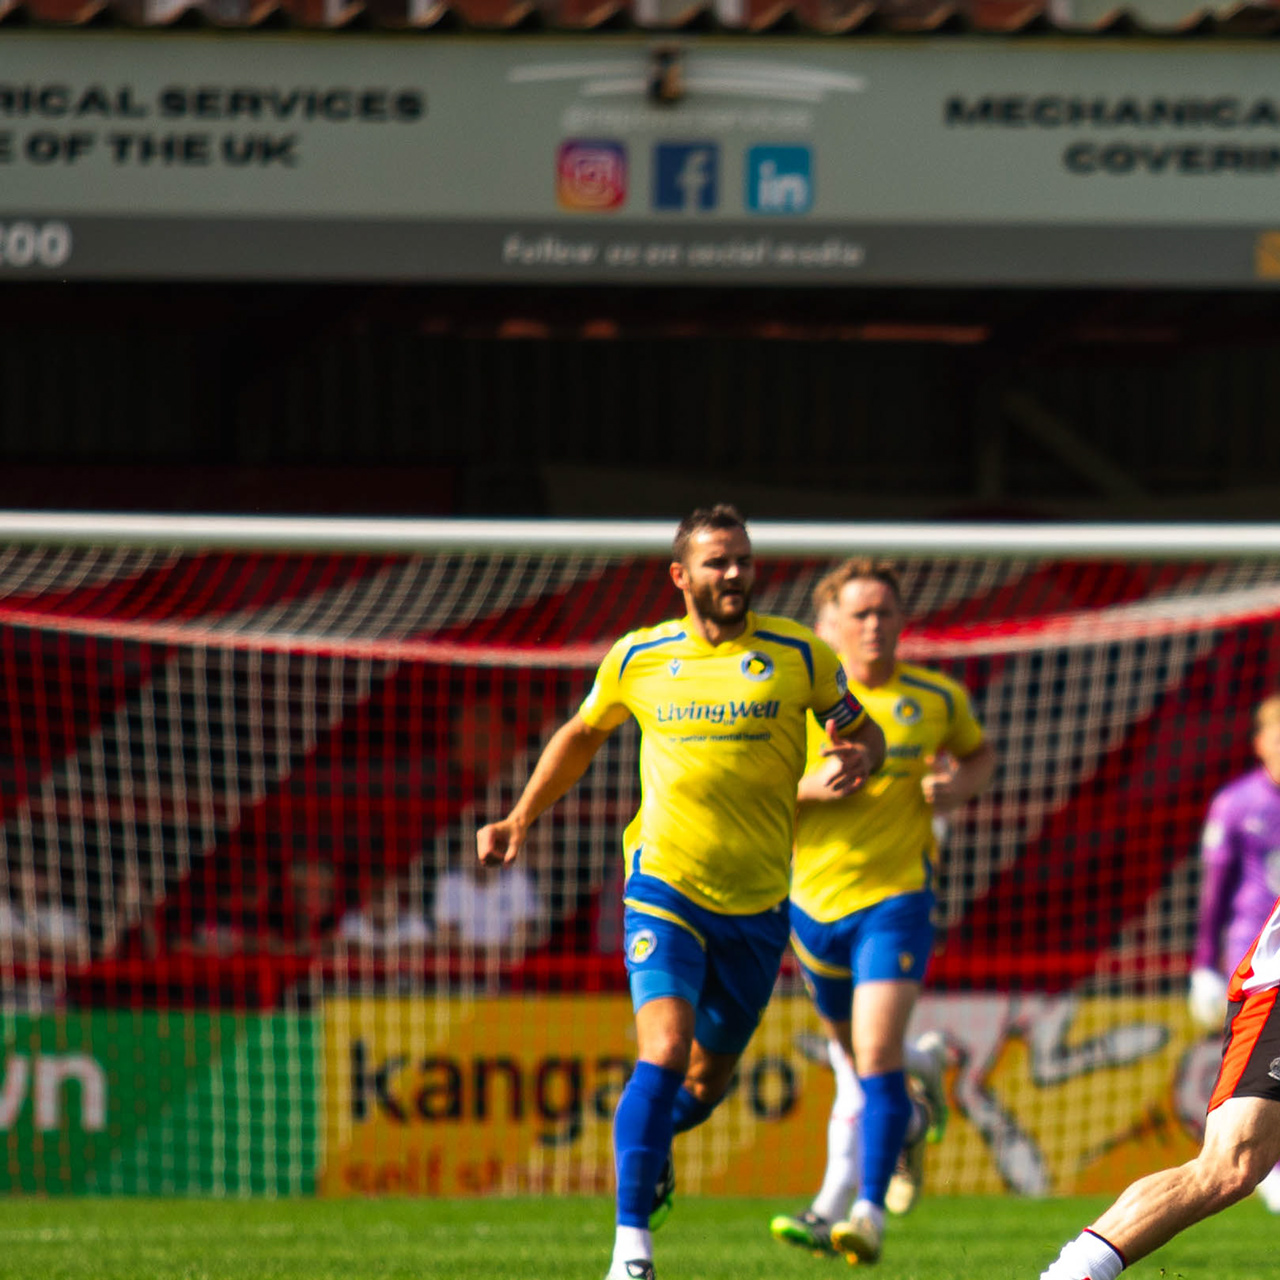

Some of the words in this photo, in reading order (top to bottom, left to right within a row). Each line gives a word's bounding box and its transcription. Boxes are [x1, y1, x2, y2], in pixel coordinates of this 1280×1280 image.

[160, 86, 428, 123] SERVICES
[25, 131, 96, 166] OF
[105, 132, 211, 167] THE
[221, 133, 301, 169] UK
[0, 221, 73, 268] 00
[349, 1040, 798, 1146] kangao
